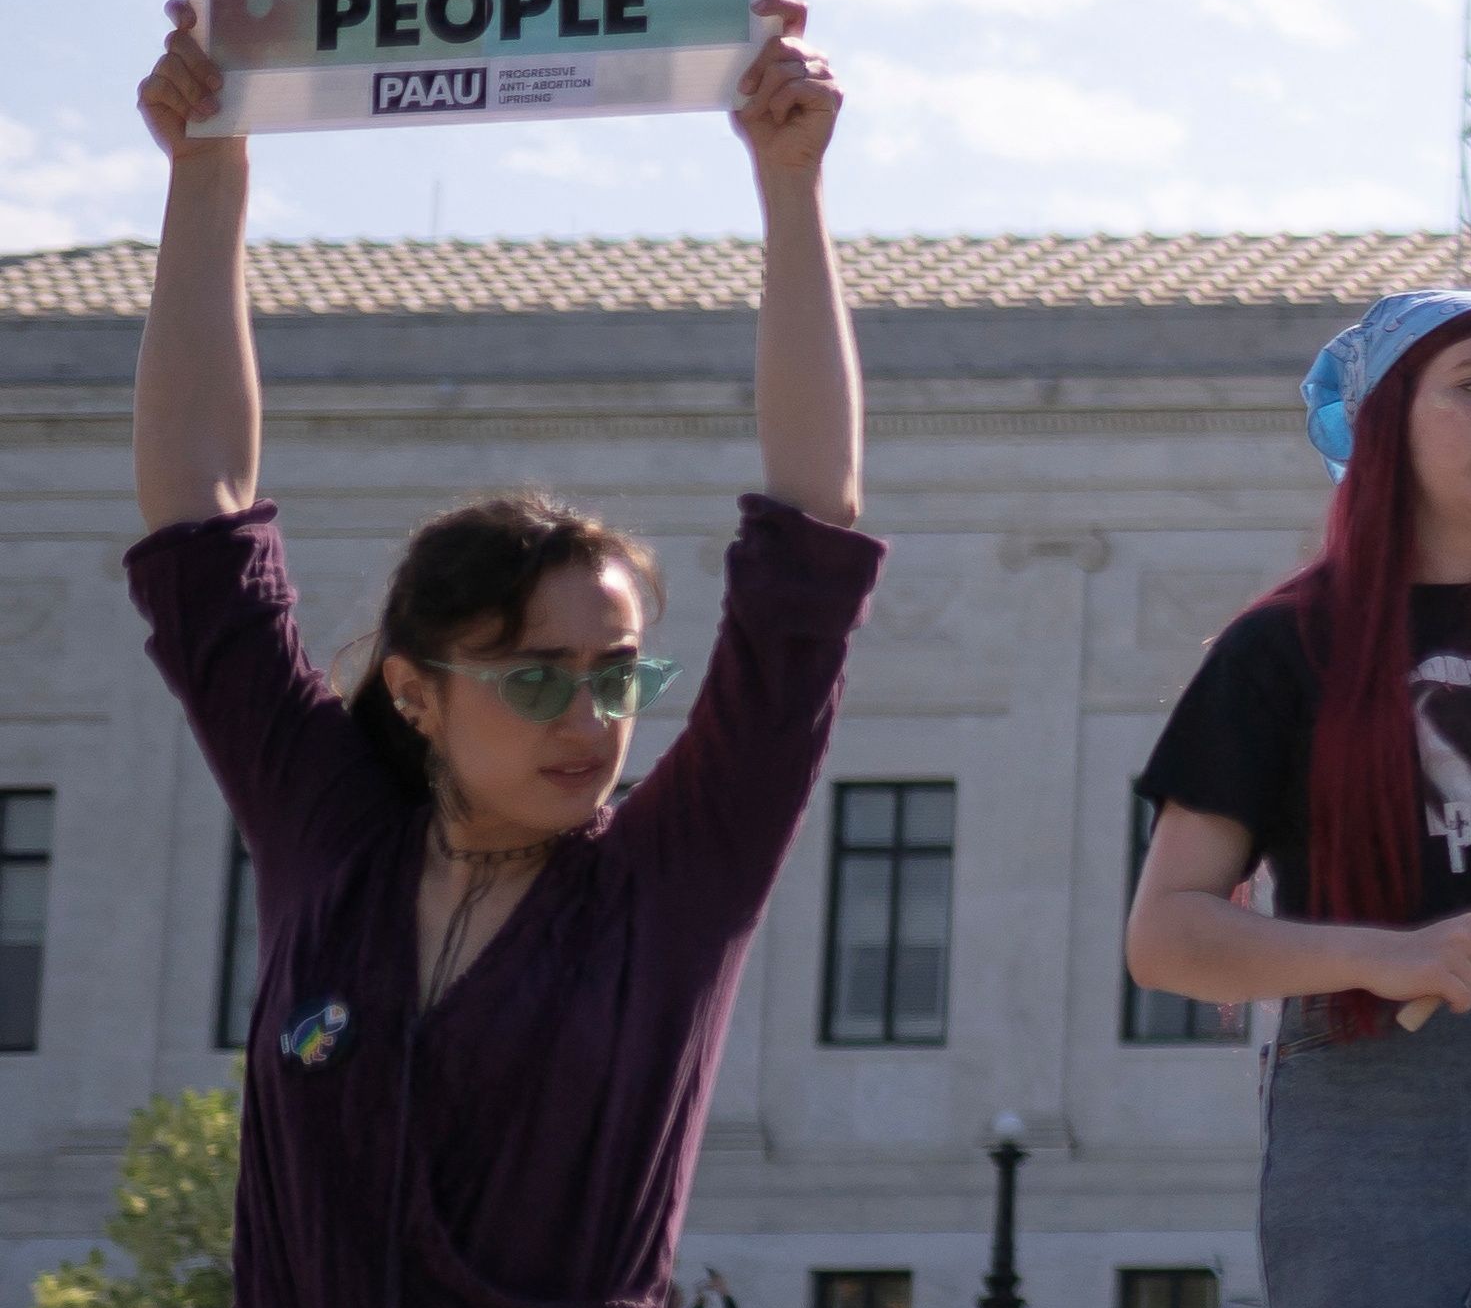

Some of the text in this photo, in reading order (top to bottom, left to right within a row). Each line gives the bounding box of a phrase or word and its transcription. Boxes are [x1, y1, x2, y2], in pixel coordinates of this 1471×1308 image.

[498, 66, 577, 80] PROGRESSIVE
[379, 72, 482, 111] PAAU
[498, 78, 592, 93] ANTI-ABORTION
[498, 93, 552, 105] UPRISING
